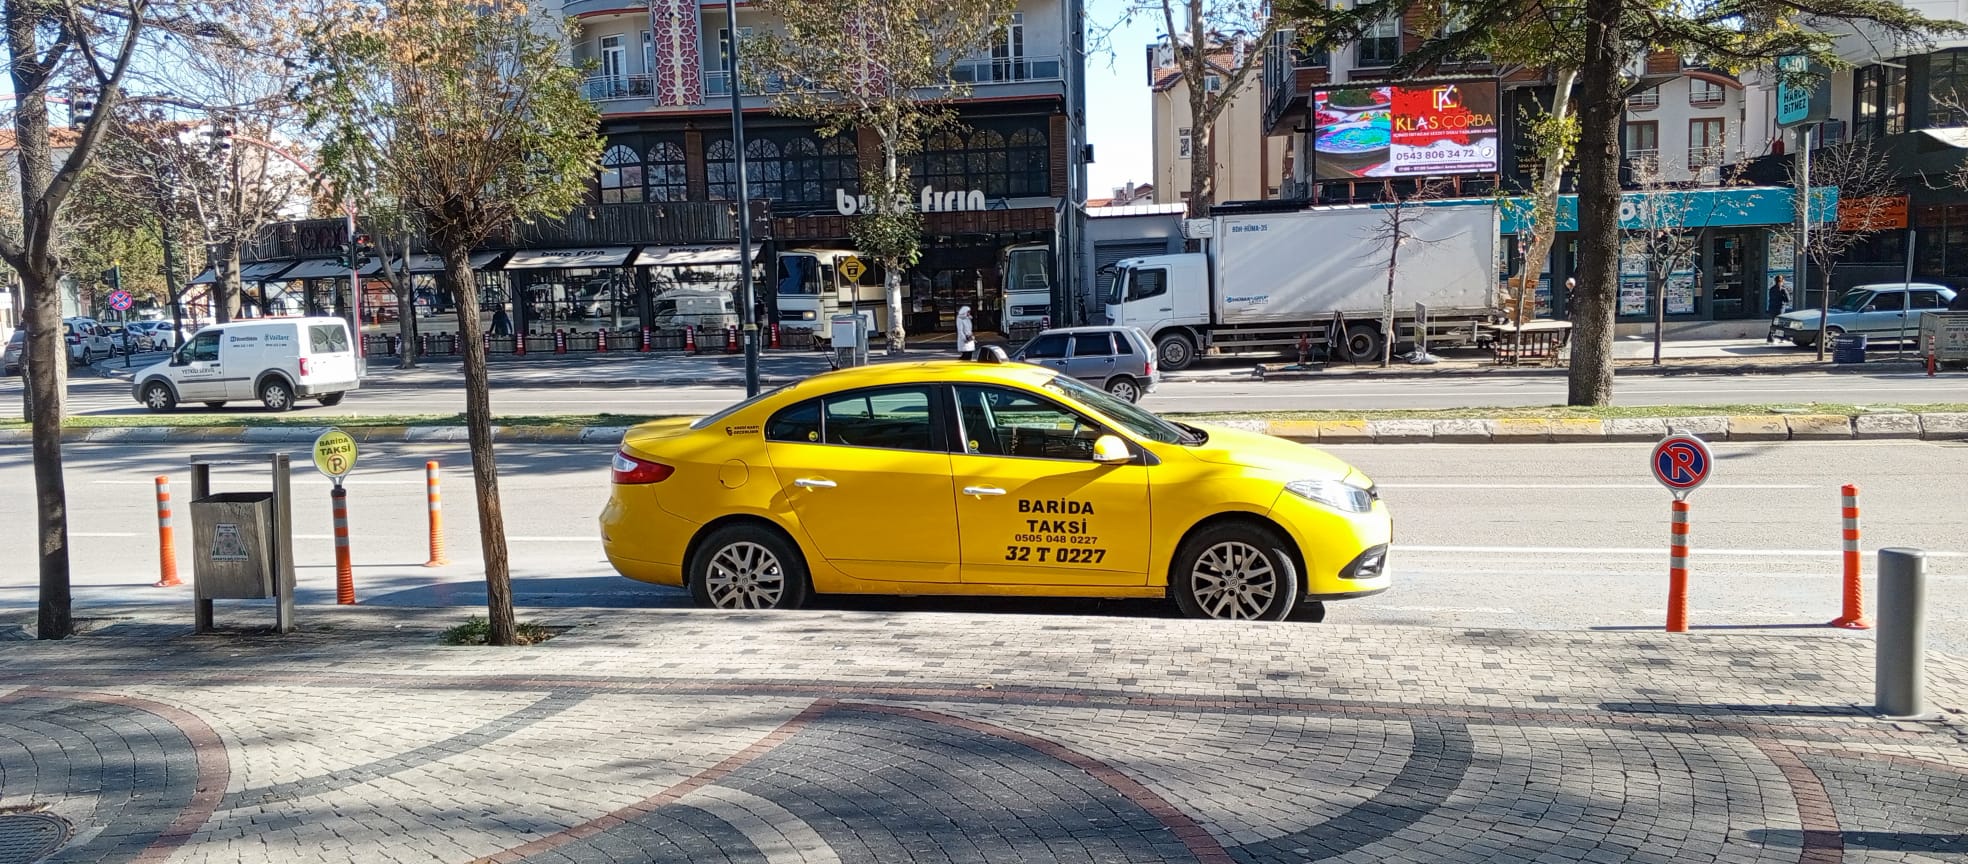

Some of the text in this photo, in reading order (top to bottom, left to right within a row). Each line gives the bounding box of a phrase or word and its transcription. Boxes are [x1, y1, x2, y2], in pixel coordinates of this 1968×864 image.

[1784, 99, 1806, 114] BİTMEZ
[1396, 114, 1494, 131] KLAS ÇORBA
[1396, 149, 1475, 160] 0543 806 34 72
[319, 437, 349, 447] BARİDA
[320, 444, 351, 456] TAKSİ
[1018, 497, 1095, 515] BARİDA
[1026, 518, 1087, 534] TAKSİ
[1015, 534, 1098, 544] 0505 048 0227
[1005, 546, 1107, 563] 32 T 0227
